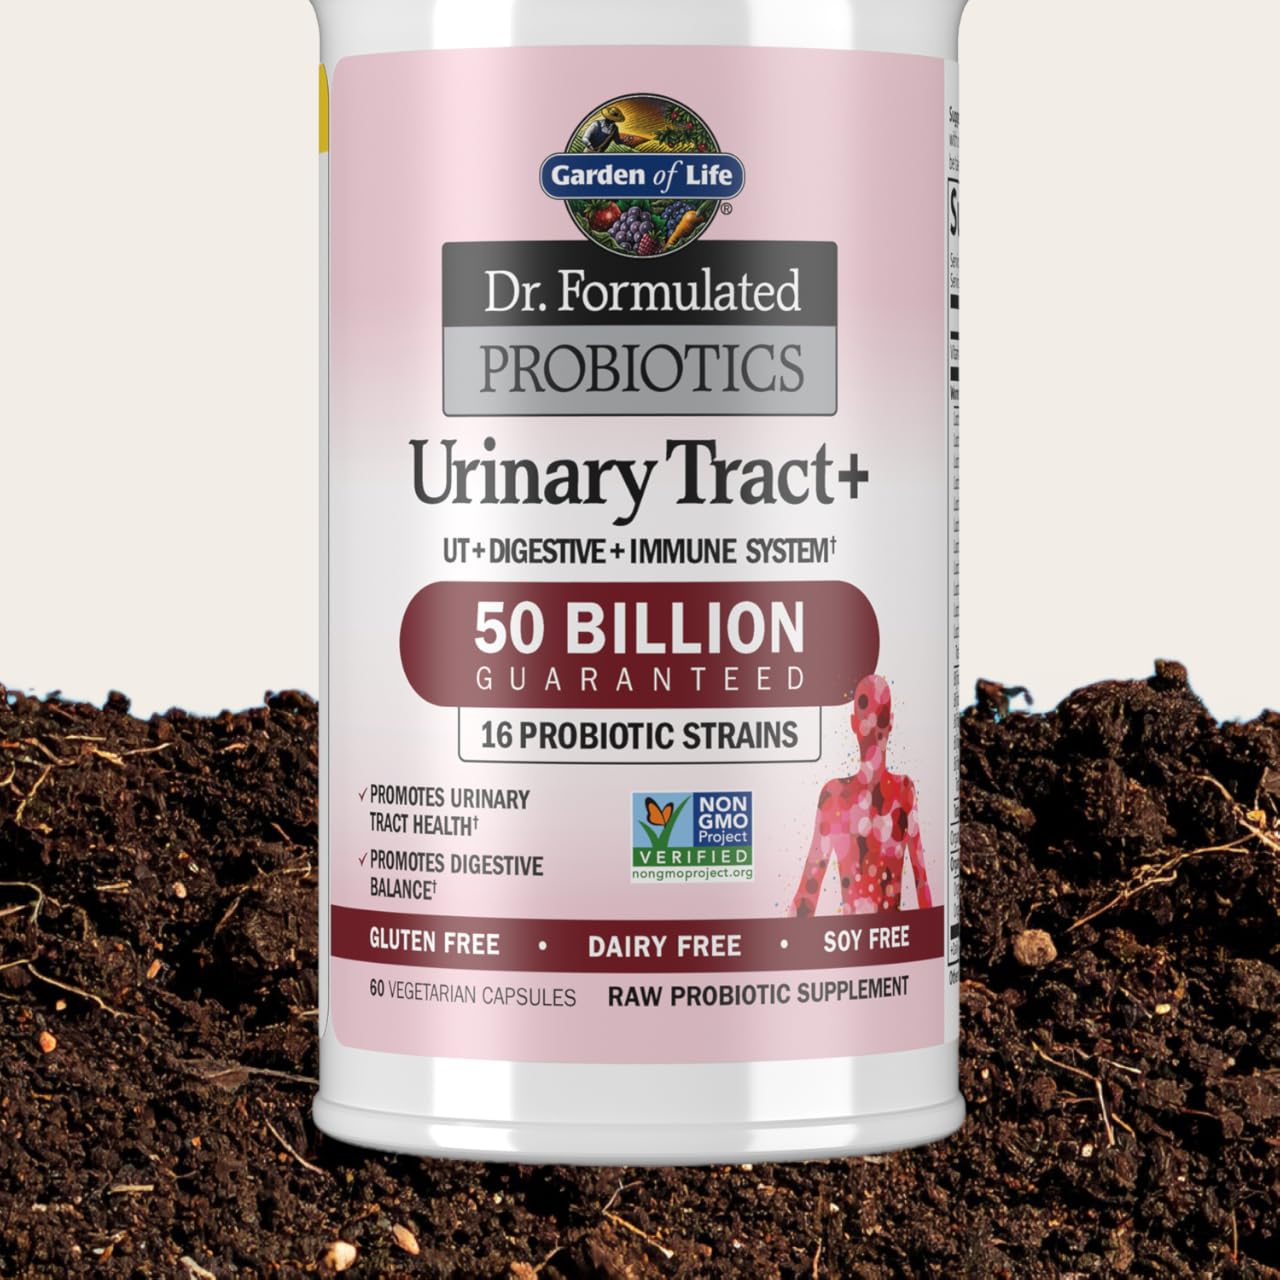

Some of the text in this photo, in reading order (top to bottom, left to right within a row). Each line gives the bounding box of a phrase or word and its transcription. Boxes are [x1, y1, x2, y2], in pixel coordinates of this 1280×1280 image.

[551, 160, 733, 194] Garden of Life
[485, 267, 802, 312] Dr. Formulated
[480, 344, 804, 392] PROBIOTICS
[408, 436, 658, 526] Urinary
[474, 601, 804, 654] 50 BILLION
[476, 666, 804, 692] GUARANTEED
[481, 721, 799, 749] 16 PROBIOTIC STRAINS
[370, 784, 530, 809] PROMOTES URINARY
[699, 796, 747, 813] NON
[370, 812, 409, 833] TRACT
[698, 813, 748, 829] GMO
[699, 830, 748, 846] Project
[370, 849, 544, 876] PROMOTES DIGESTIVE
[639, 849, 748, 864] VERIFIED
[632, 868, 753, 881] nongmoproject.org
[370, 925, 910, 957] GLUTEN FREE DAIRY FREE SOY FREE
[370, 978, 577, 1007] 60 VEGETARIAN CAPSULES
[608, 975, 909, 1007] RAW PROBIOTIC SUPPLEMENT
